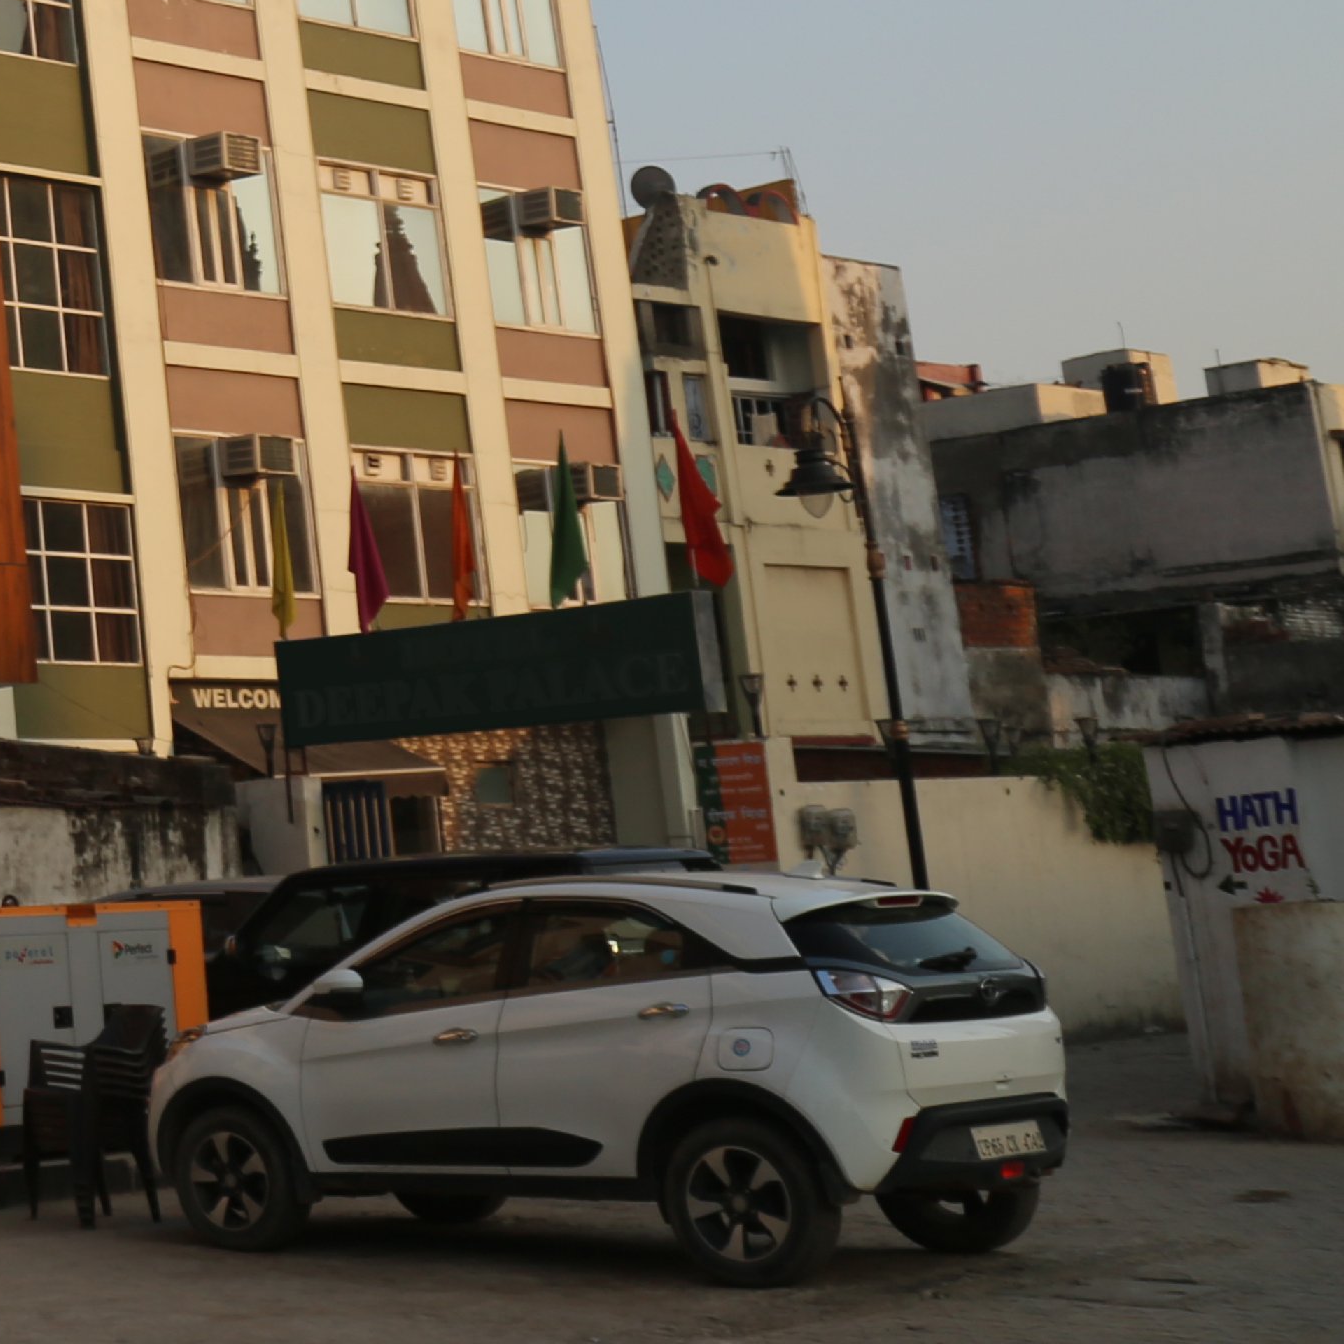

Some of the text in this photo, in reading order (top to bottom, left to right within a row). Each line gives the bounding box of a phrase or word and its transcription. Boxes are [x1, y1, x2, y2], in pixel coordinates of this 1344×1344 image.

[294, 651, 690, 729] DEEPAK PALACE
[1216, 787, 1298, 832] HATH
